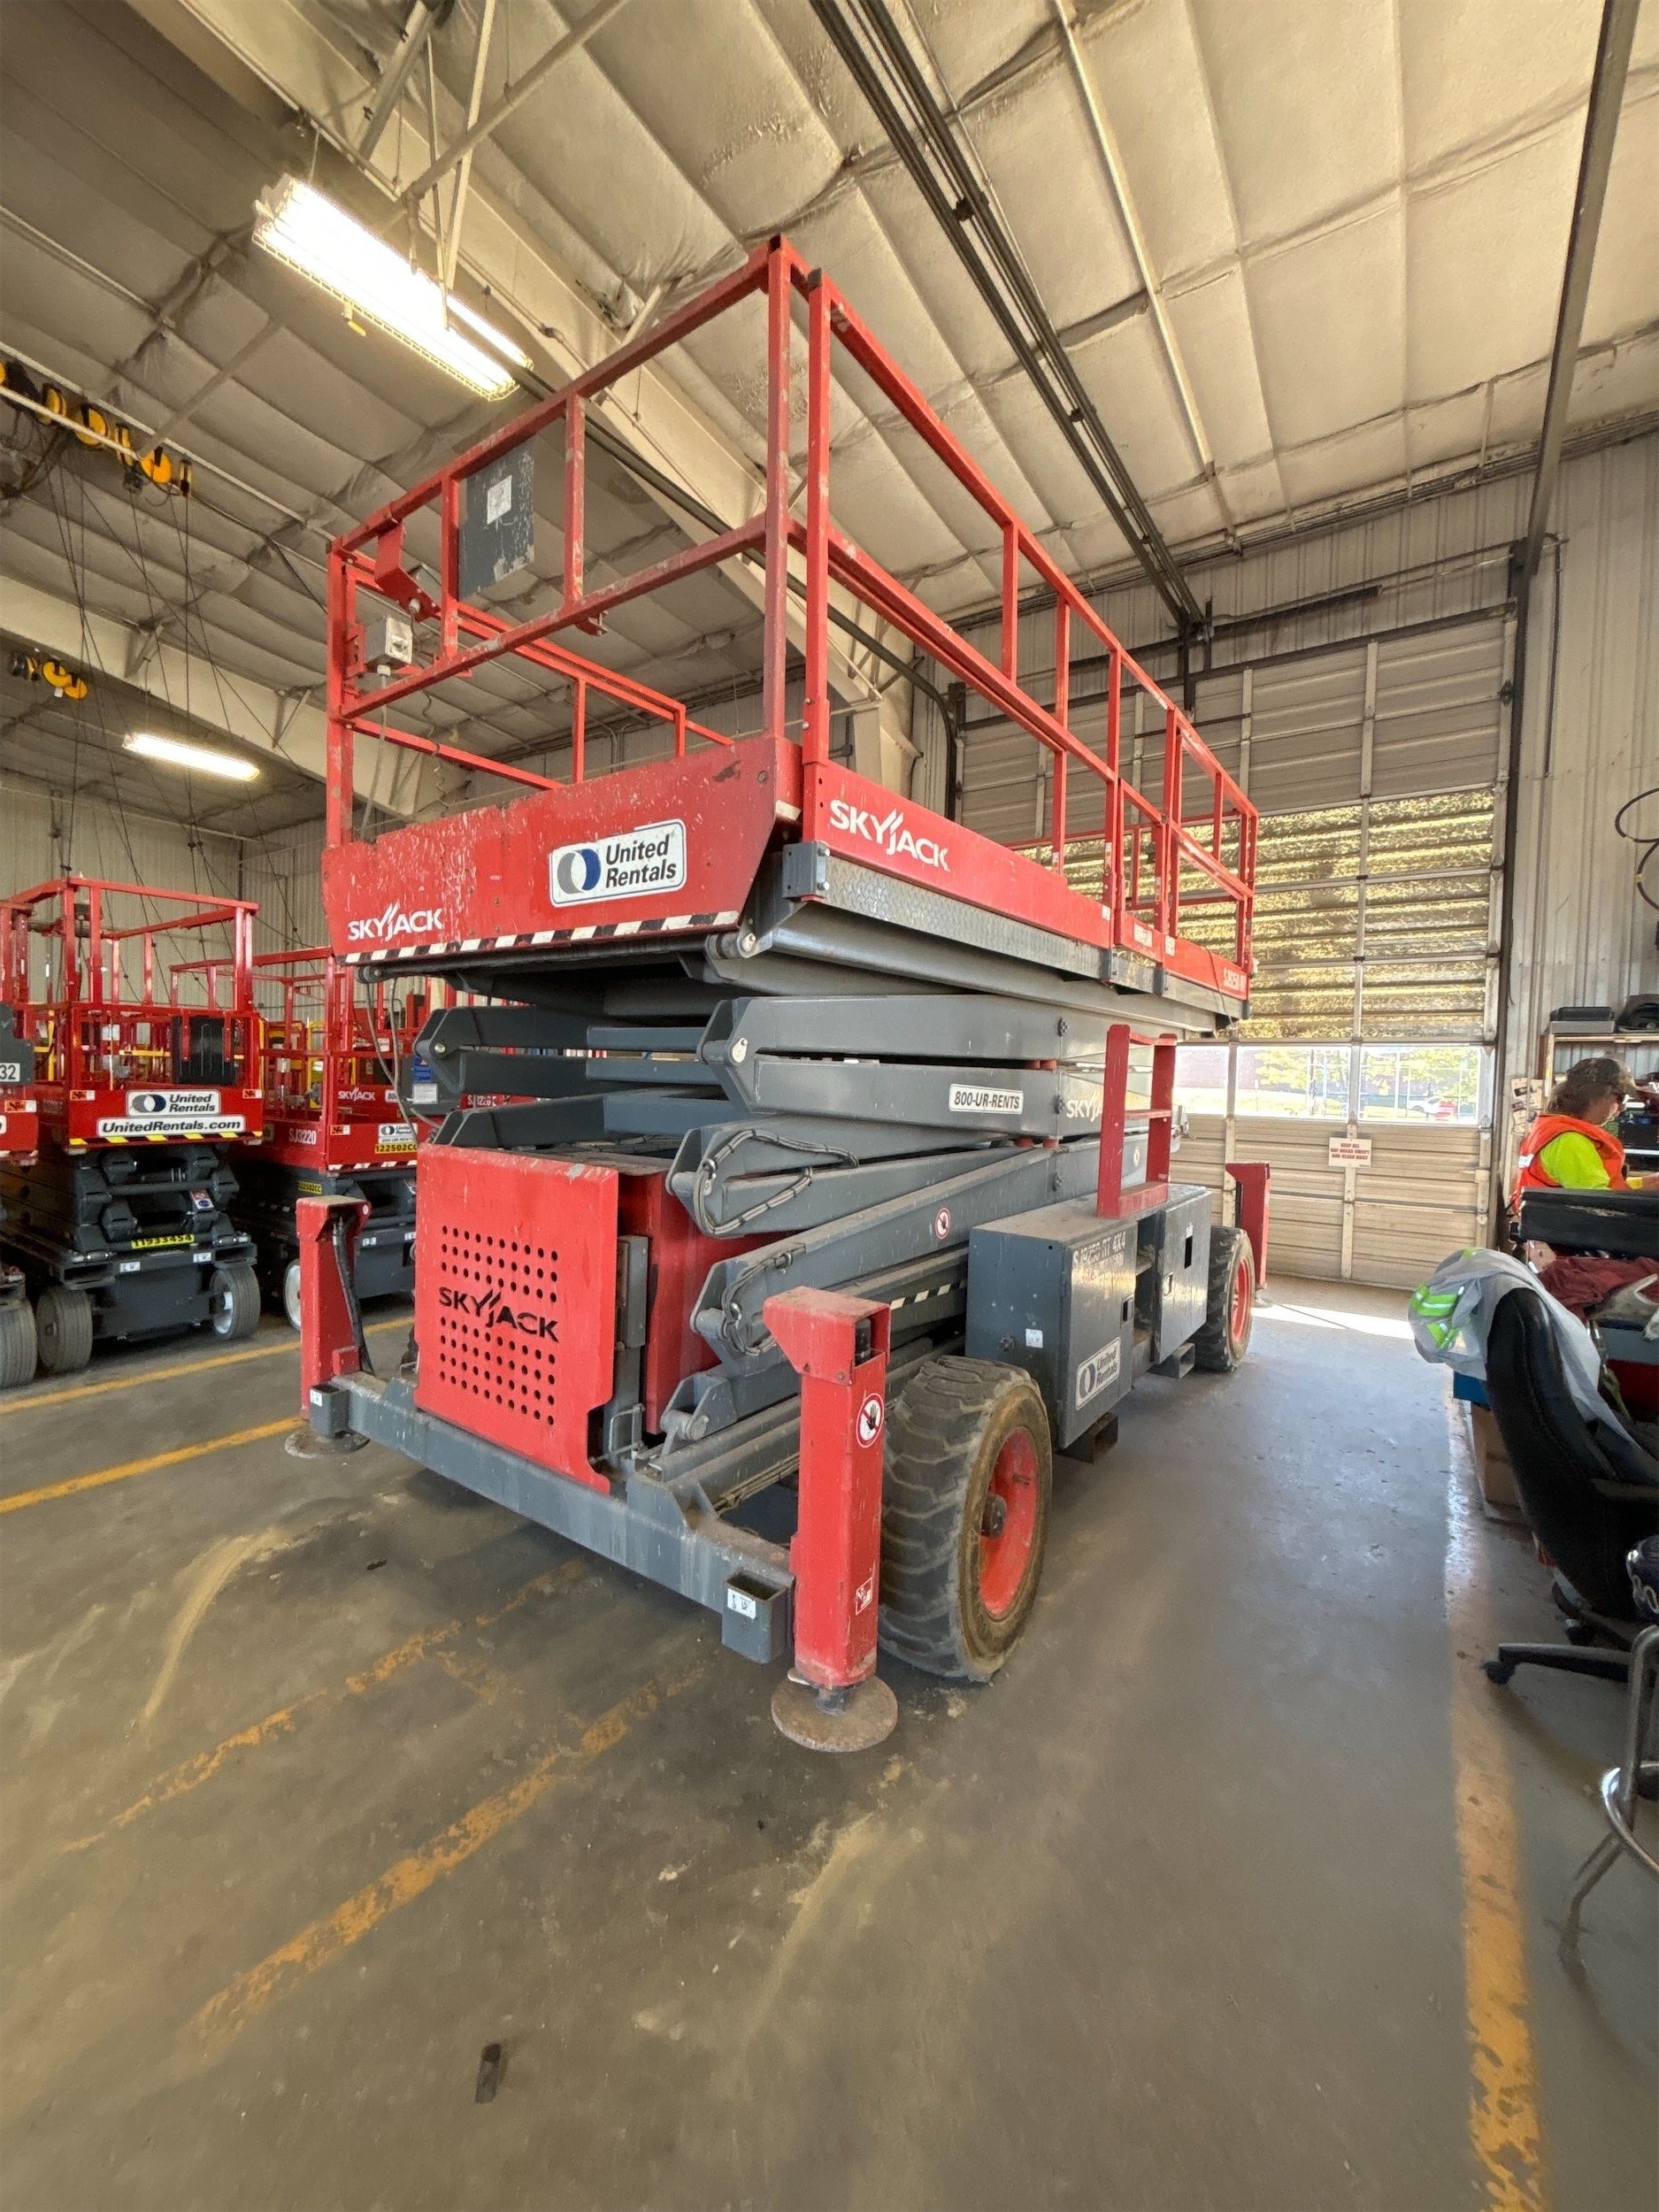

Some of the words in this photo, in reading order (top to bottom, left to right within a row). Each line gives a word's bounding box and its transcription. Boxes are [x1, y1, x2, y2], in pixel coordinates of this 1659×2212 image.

[830, 799, 950, 872] SKYJACK
[606, 833, 671, 864] United
[606, 857, 677, 888] Rentals
[348, 901, 442, 941] SKYJACK
[169, 1094, 211, 1104] United
[338, 1087, 375, 1102] SKYJACK
[954, 1091, 1020, 1110] 800-UR-RENTS
[169, 1102, 215, 1112] Rentals
[1066, 1088, 1102, 1122] SKYJA
[103, 1120, 241, 1133] UnitedRentals.com
[288, 1128, 317, 1145] SJ3220
[134, 1234, 192, 1247] 11933454
[439, 1286, 559, 1343] SKYJACK
